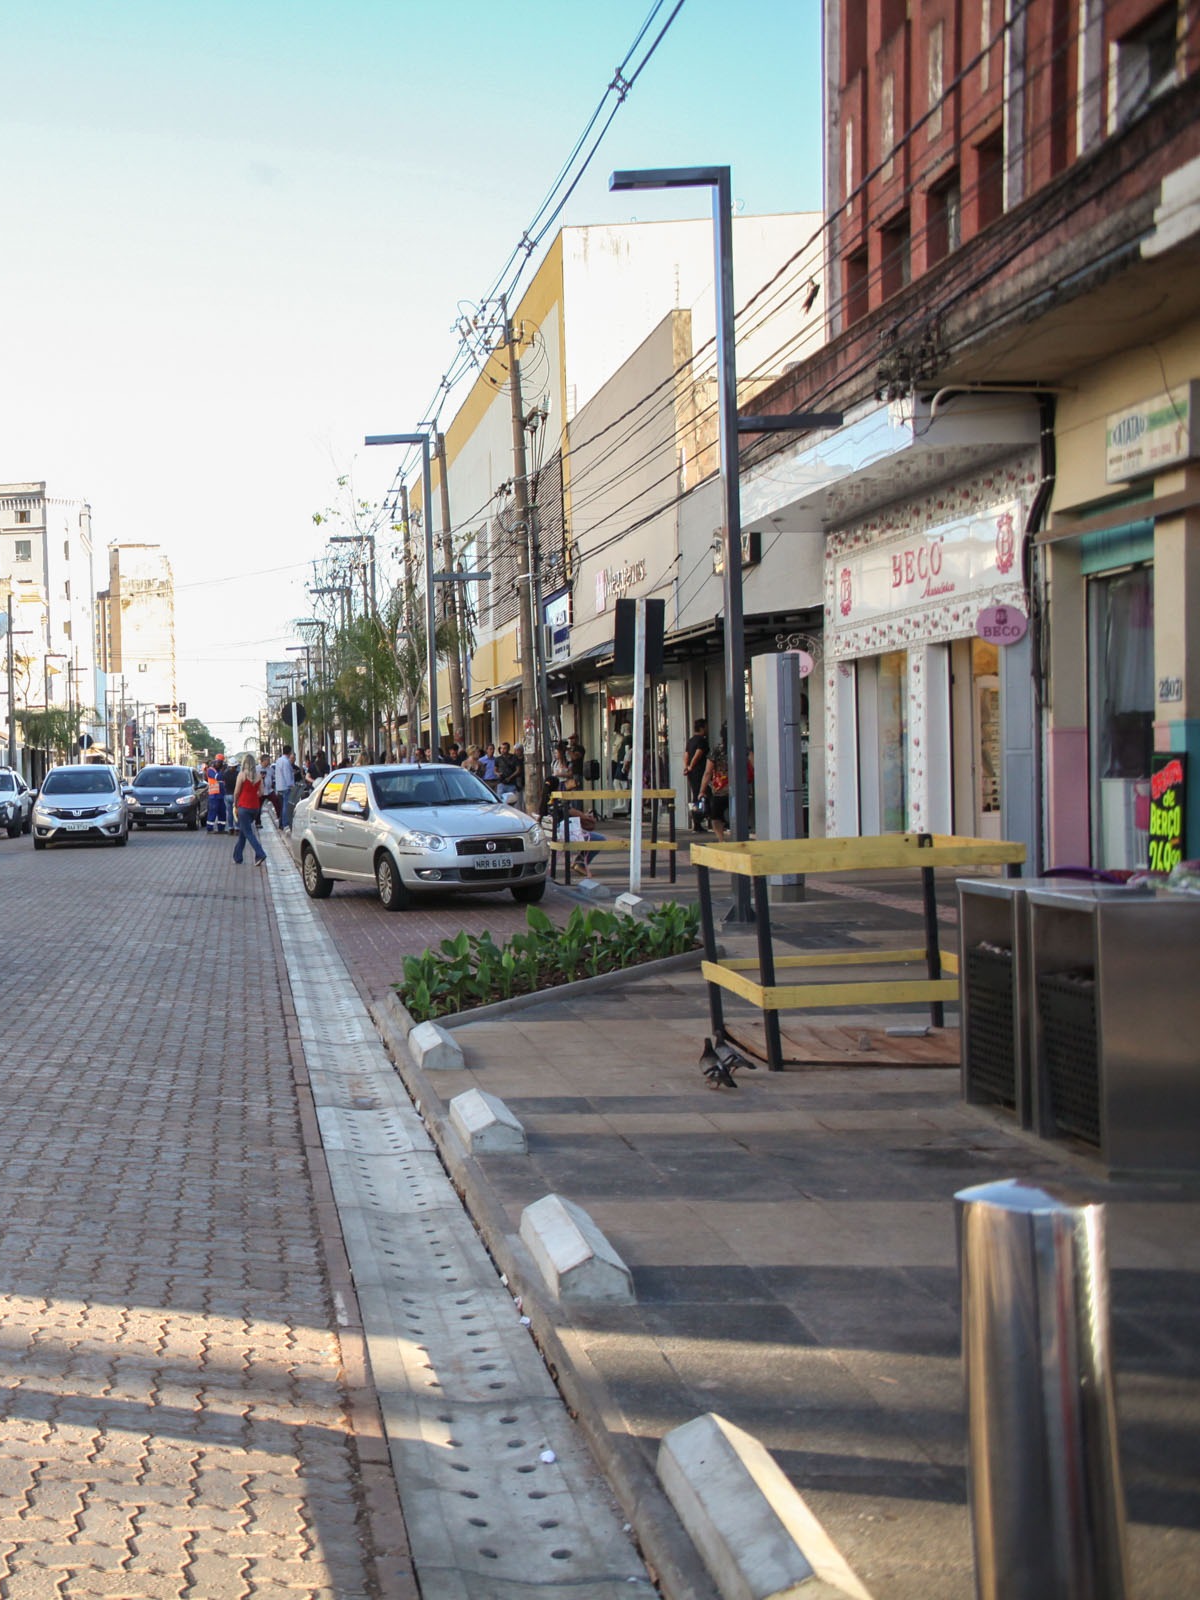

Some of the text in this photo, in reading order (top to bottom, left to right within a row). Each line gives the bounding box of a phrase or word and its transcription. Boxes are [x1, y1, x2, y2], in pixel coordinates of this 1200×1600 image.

[891, 541, 943, 588] BECO
[983, 625, 1021, 637] BECO
[1162, 789, 1176, 807] de
[1149, 802, 1181, 839] BERÇO
